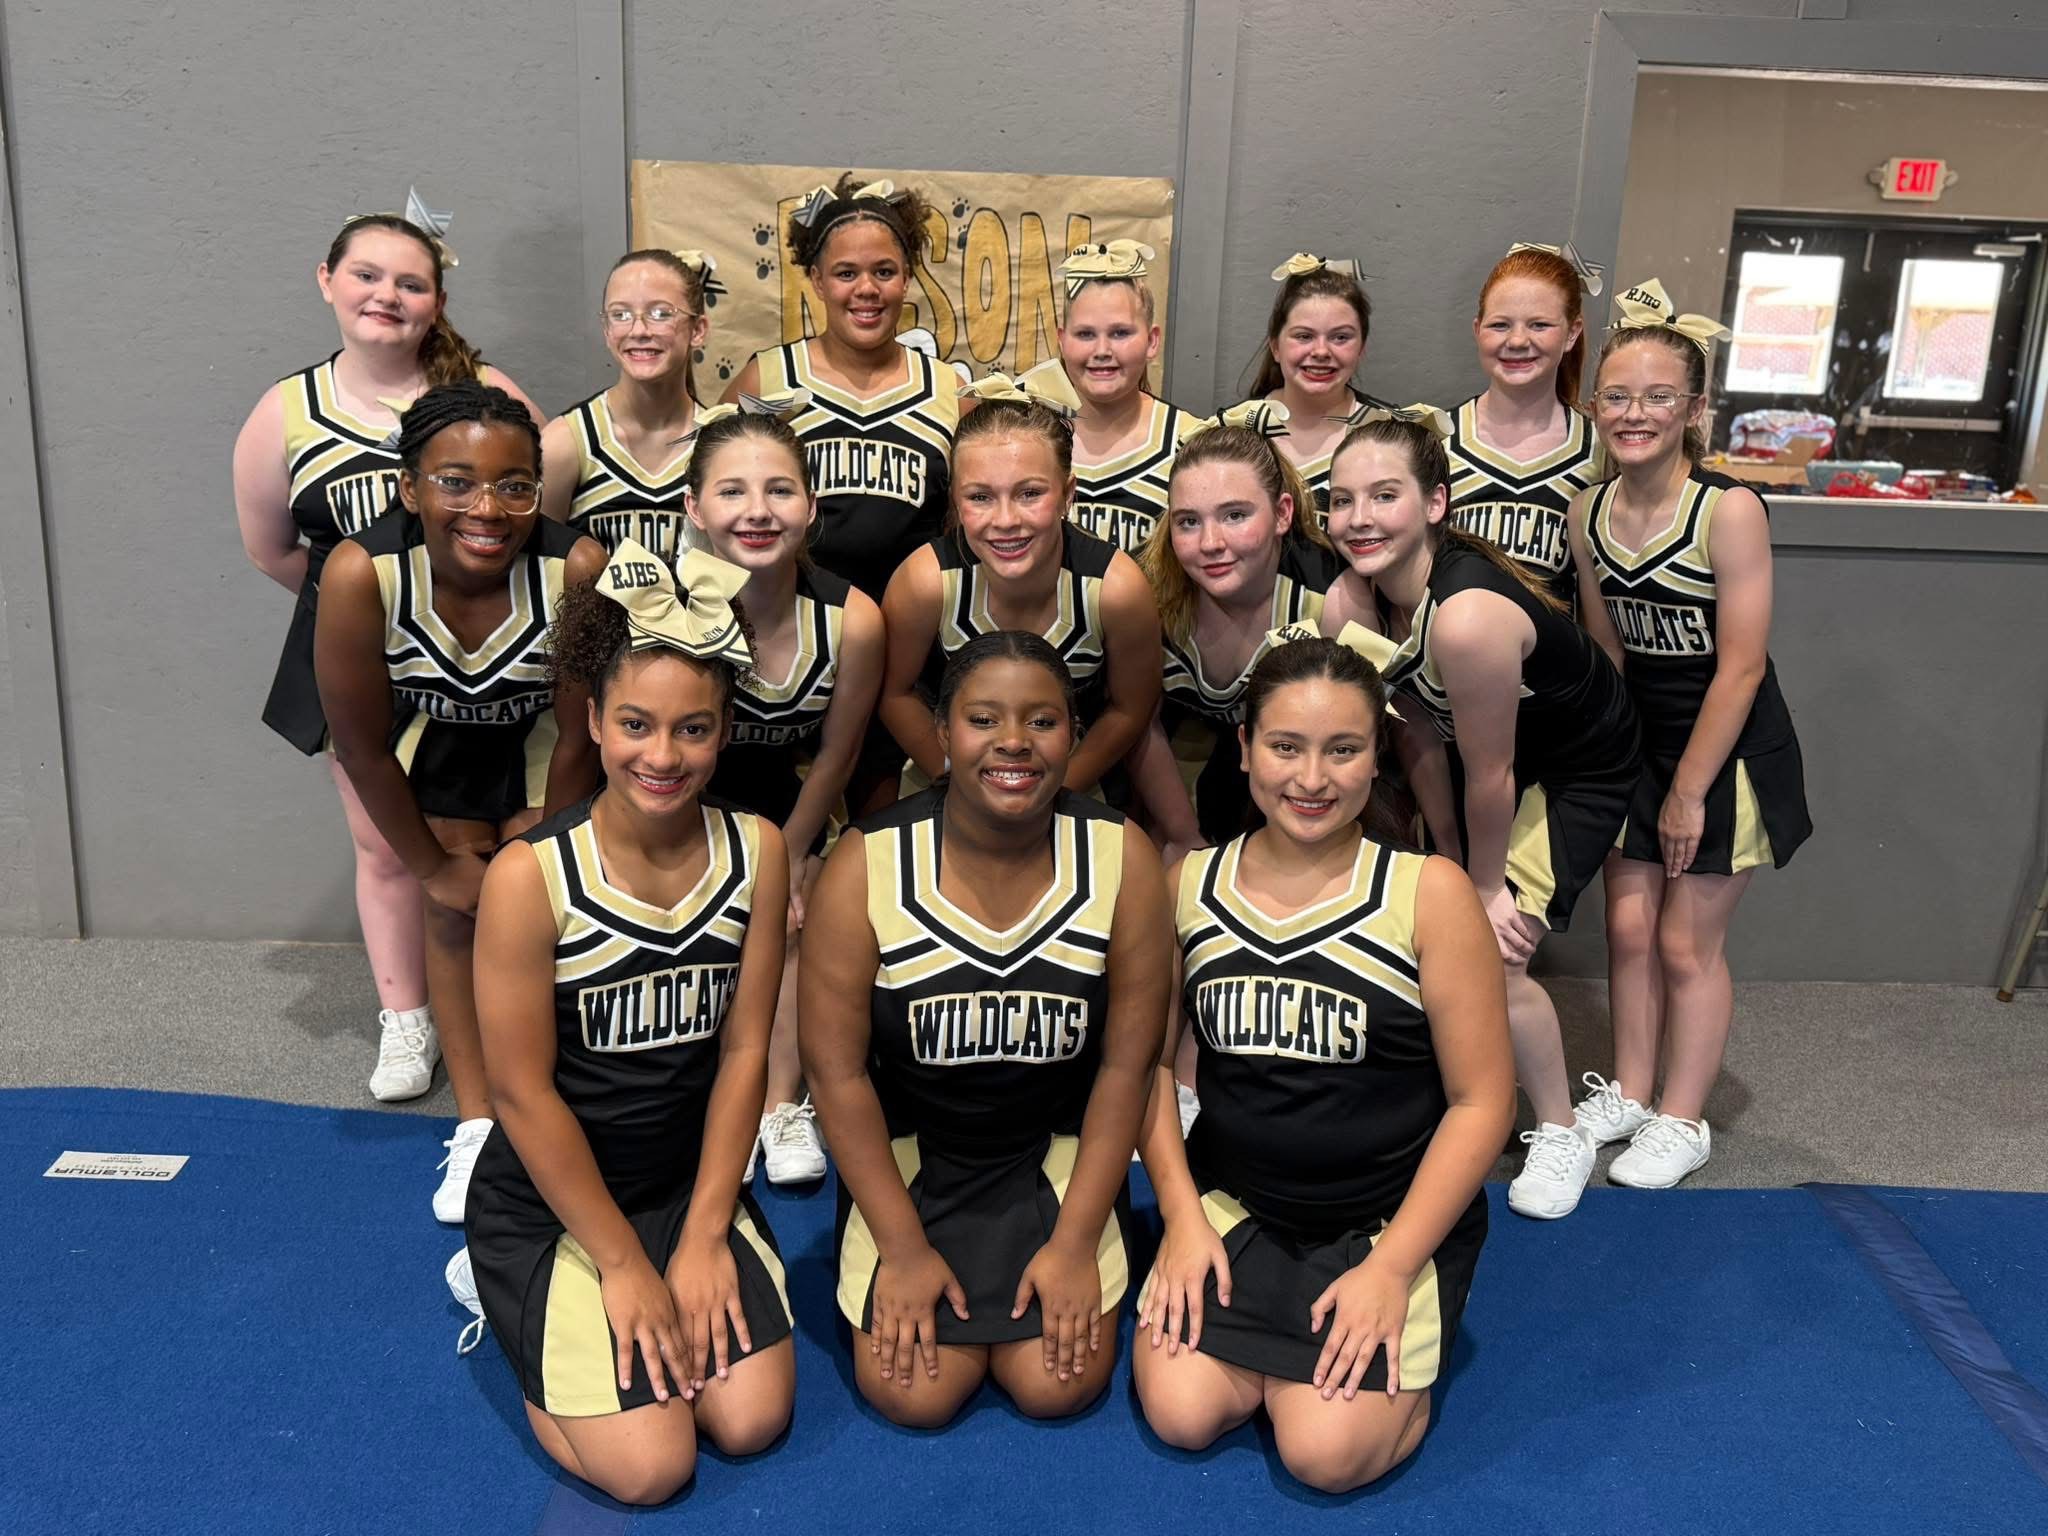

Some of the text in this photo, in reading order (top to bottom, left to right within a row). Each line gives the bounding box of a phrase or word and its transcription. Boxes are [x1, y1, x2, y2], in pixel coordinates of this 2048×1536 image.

[1896, 160, 1941, 193] EXIT
[806, 437, 927, 508] WILDCATS
[609, 561, 660, 590] RJHS
[908, 991, 1088, 1065] WILDCATS
[1196, 976, 1367, 1064] WILDCATS
